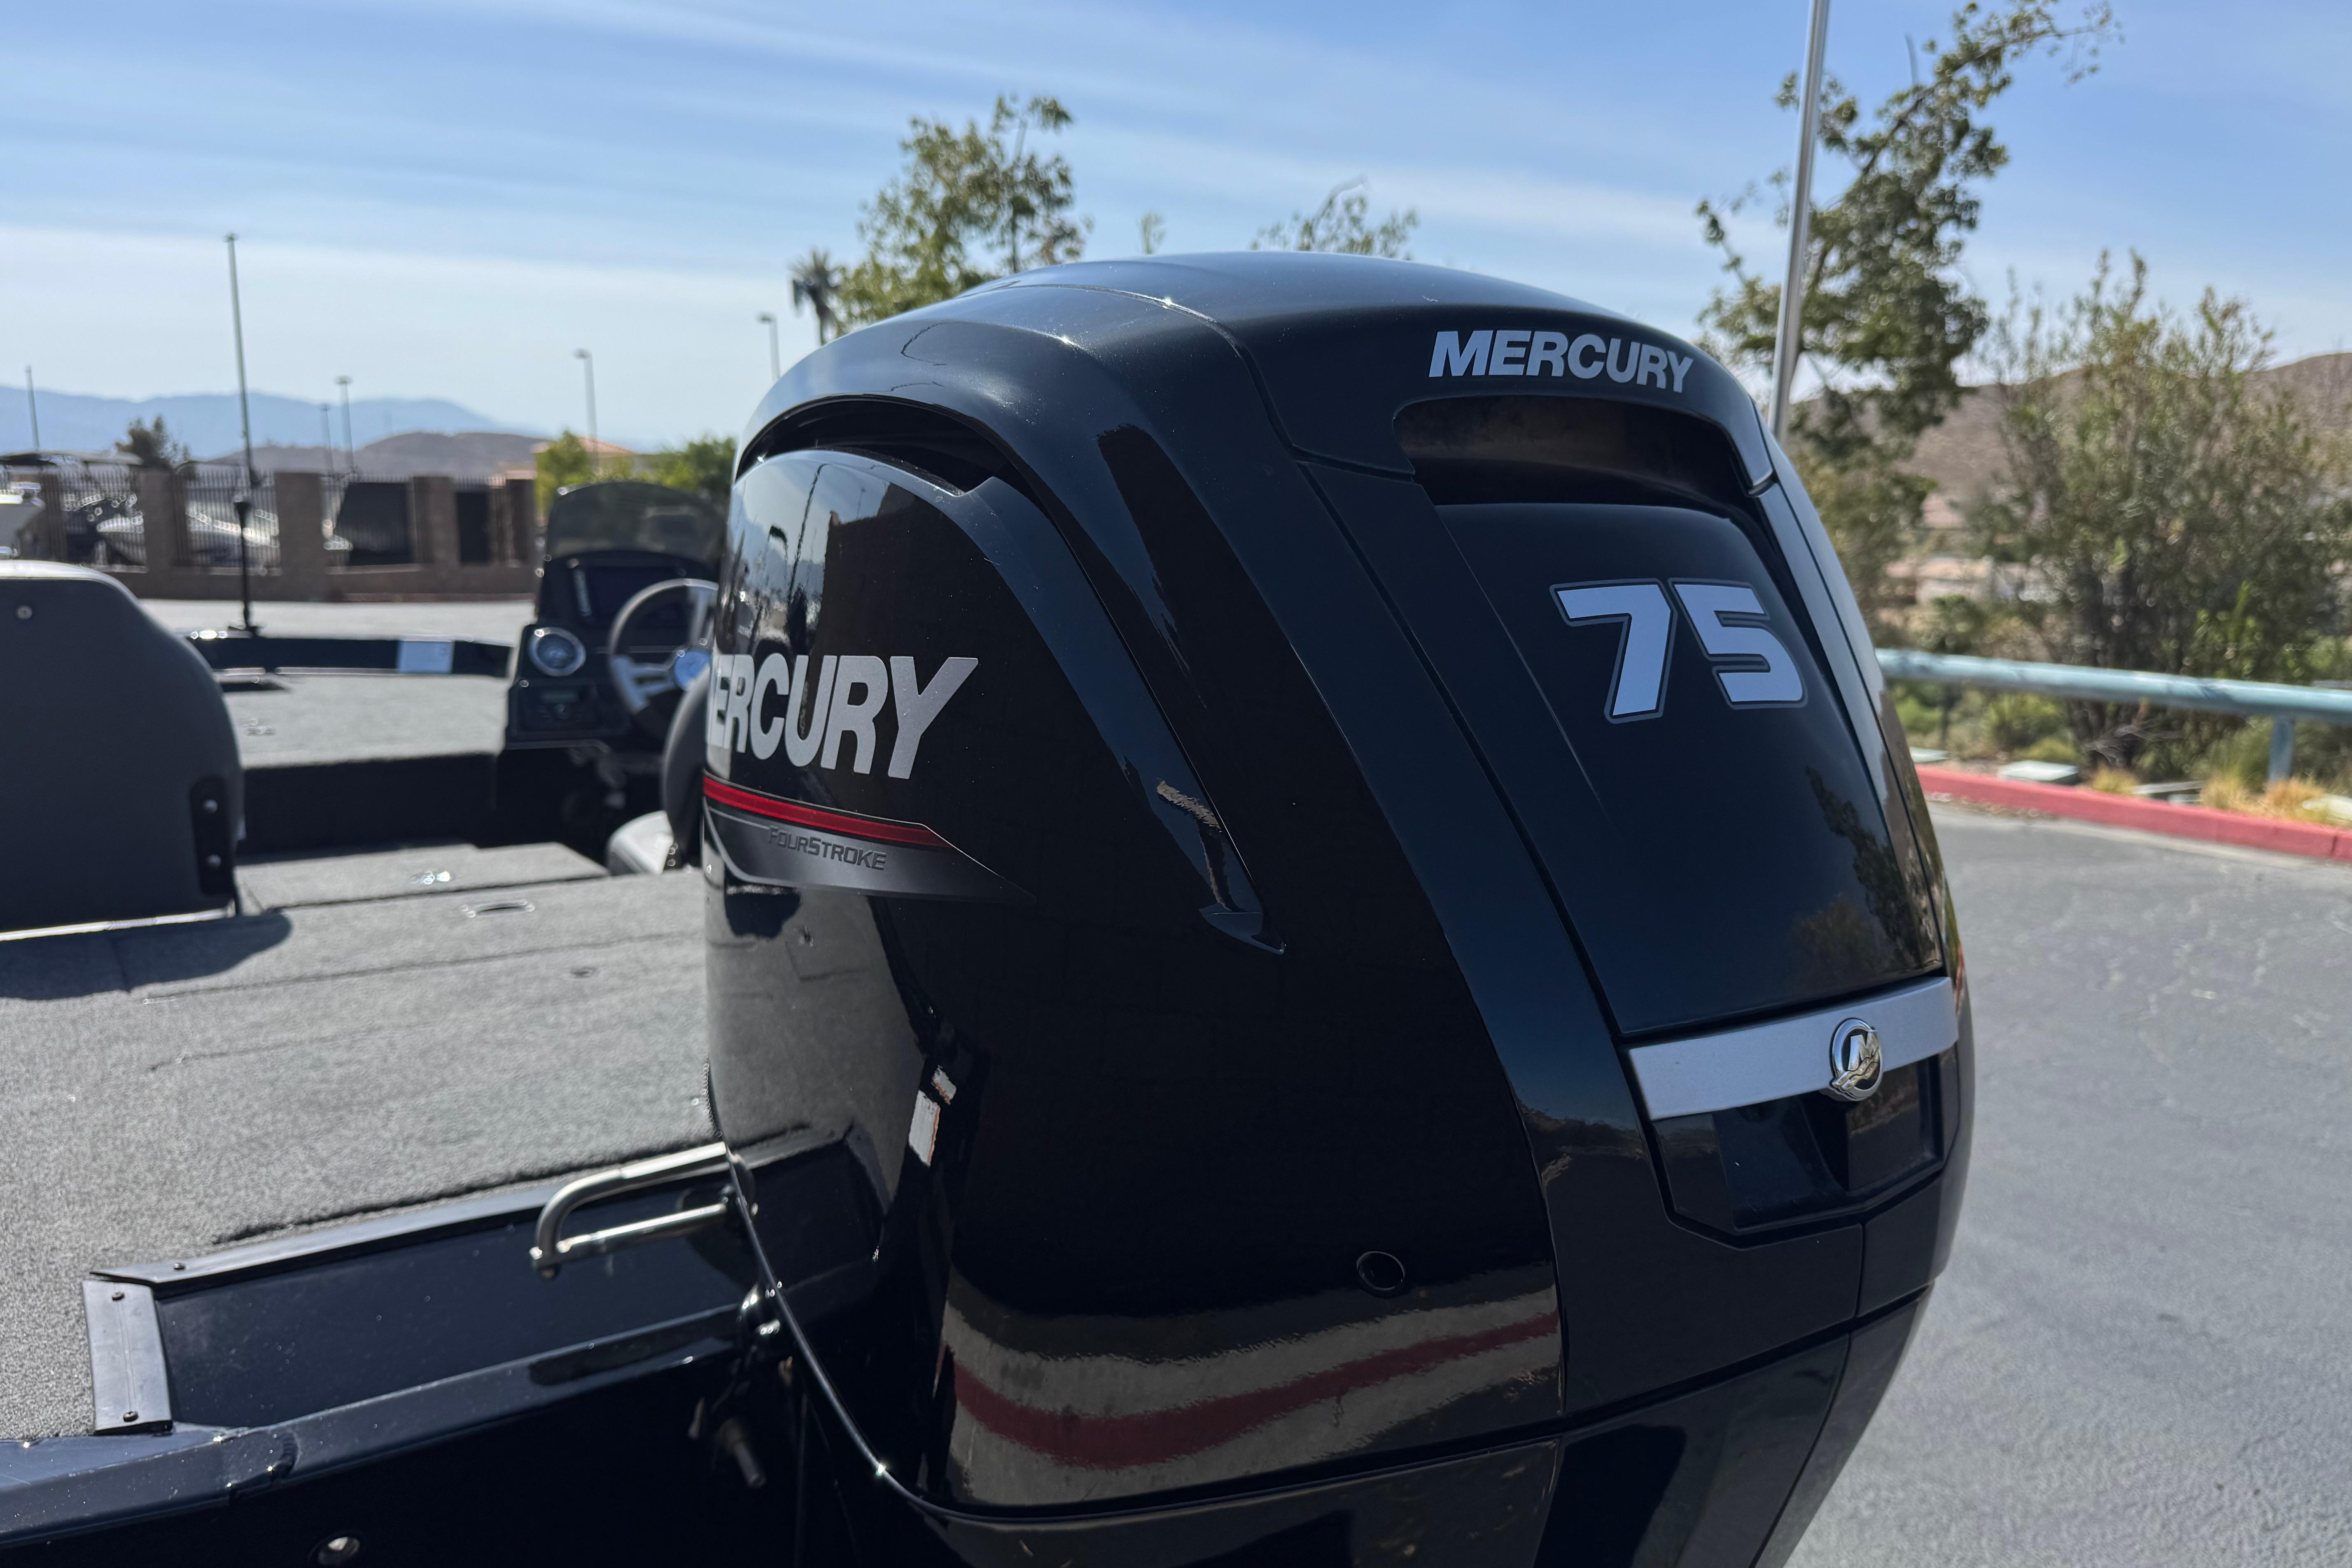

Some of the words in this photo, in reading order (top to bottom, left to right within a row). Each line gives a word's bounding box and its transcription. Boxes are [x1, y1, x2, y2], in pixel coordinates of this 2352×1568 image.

[1428, 330, 1693, 393] MERCURY
[1550, 578, 1808, 723] 75
[707, 652, 979, 779] ERCURY
[769, 825, 888, 870] FOURSTROKE
